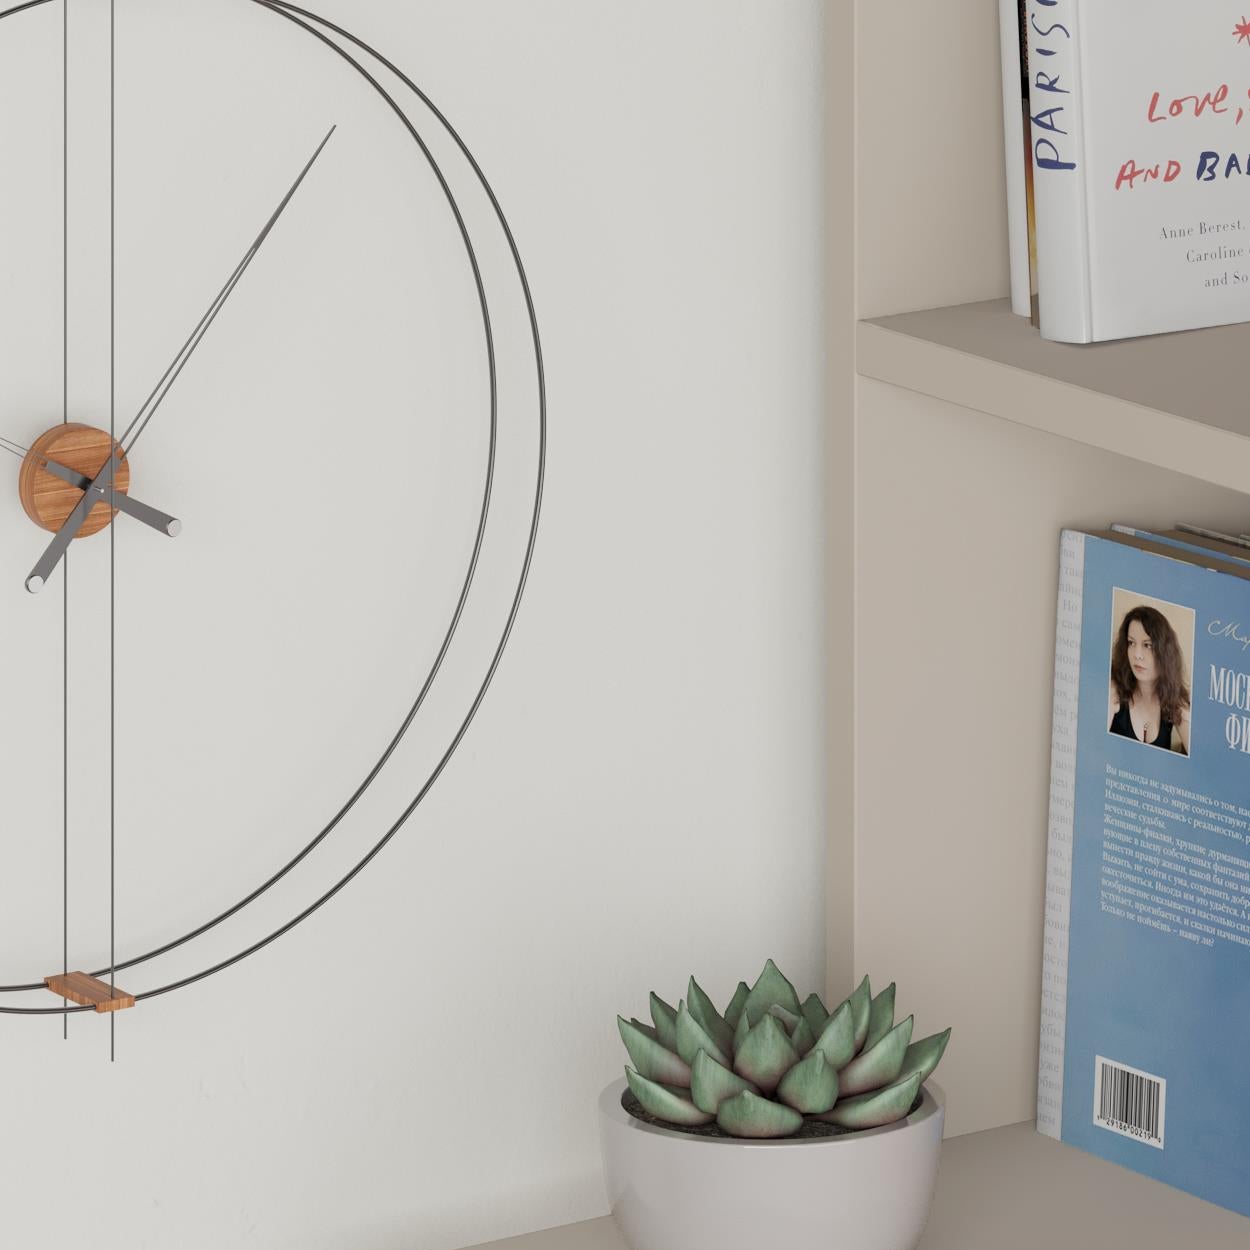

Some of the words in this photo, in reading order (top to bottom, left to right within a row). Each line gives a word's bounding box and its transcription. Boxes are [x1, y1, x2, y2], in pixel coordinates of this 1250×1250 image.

[1115, 159, 1181, 190] AND
[1159, 226, 1194, 240] Anne
[1186, 245, 1244, 263] Caroline
[1204, 271, 1229, 288] and
